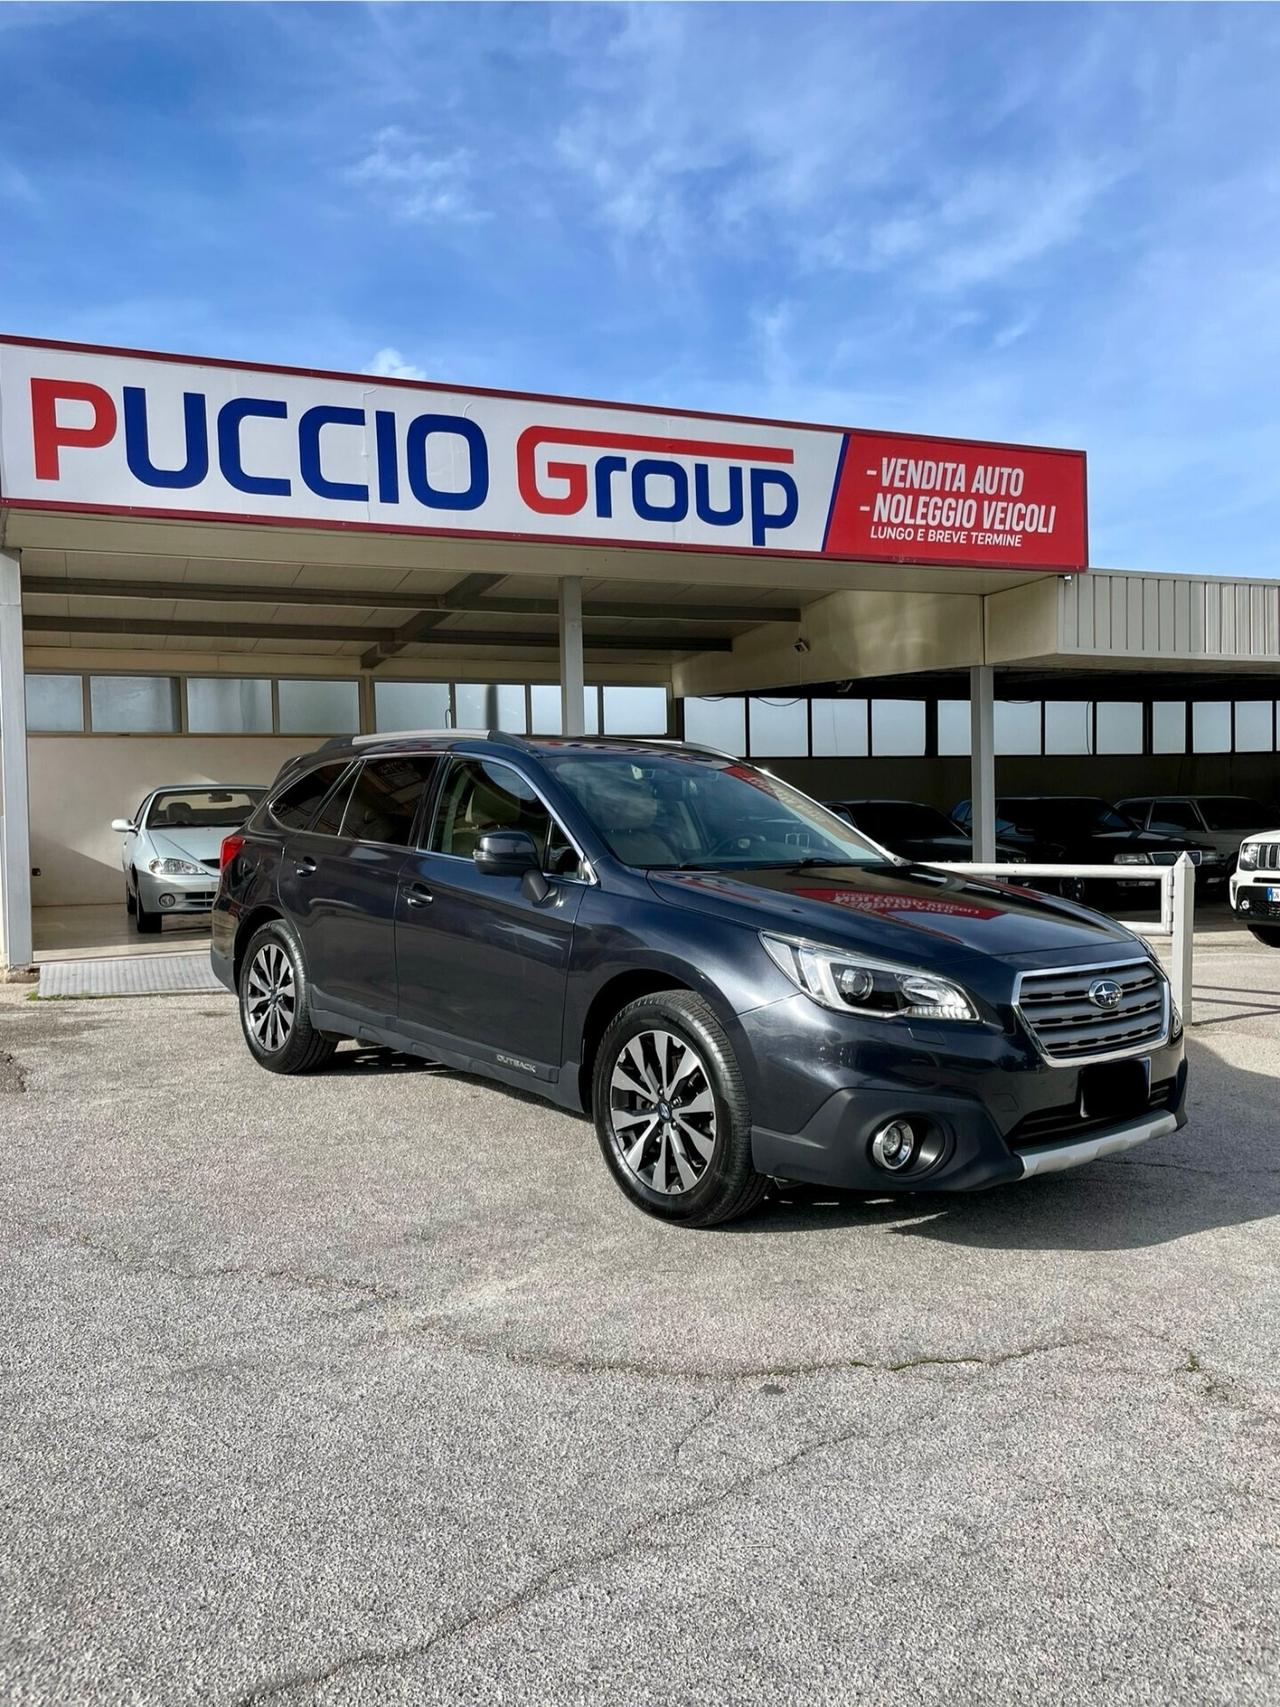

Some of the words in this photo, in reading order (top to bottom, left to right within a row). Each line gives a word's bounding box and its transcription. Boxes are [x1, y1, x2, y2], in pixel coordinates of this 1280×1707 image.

[30, 377, 490, 511] PUCCIO
[971, 465, 1025, 497] AUTO
[982, 500, 1056, 534] VEICOLI
[870, 526, 914, 541] LUNGO
[917, 528, 925, 542] E
[927, 529, 967, 544] BREVE
[970, 531, 1022, 547] TERMINE
